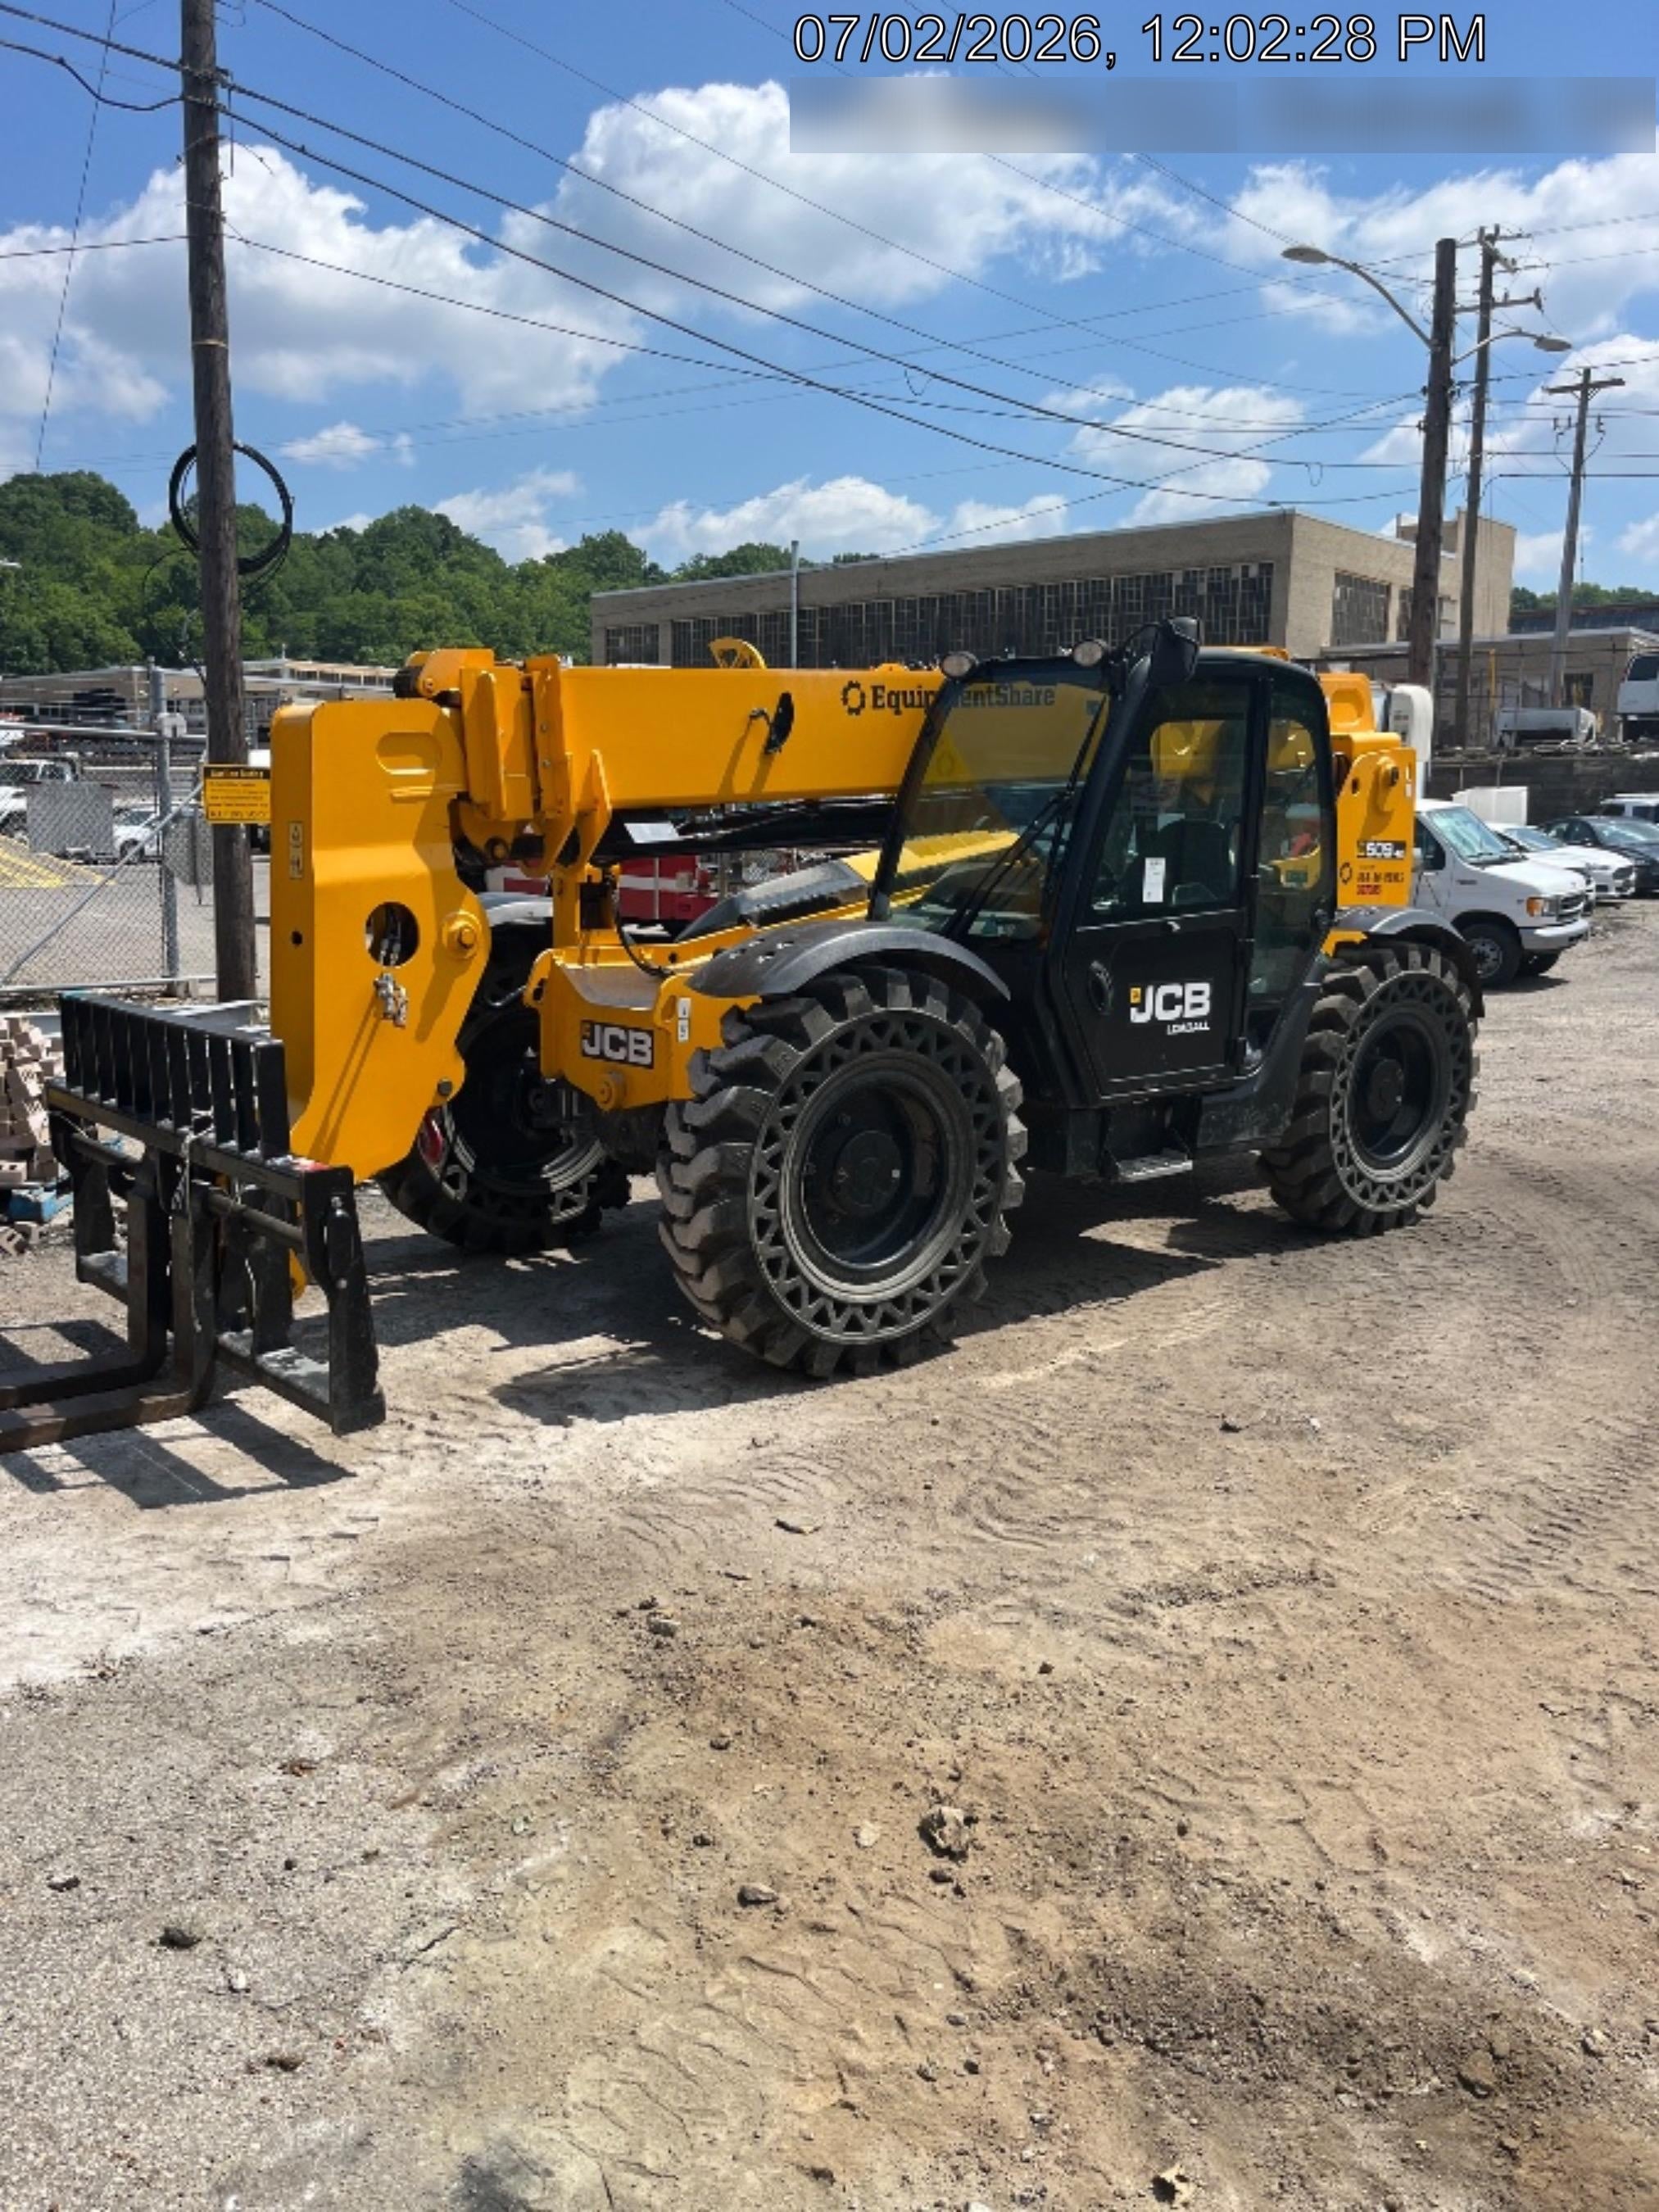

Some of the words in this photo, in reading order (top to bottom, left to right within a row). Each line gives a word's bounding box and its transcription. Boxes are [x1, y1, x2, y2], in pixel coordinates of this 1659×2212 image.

[870, 682, 1055, 715] EquipentShare
[1130, 982, 1211, 1023] JCB
[582, 1023, 652, 1065] JCB
